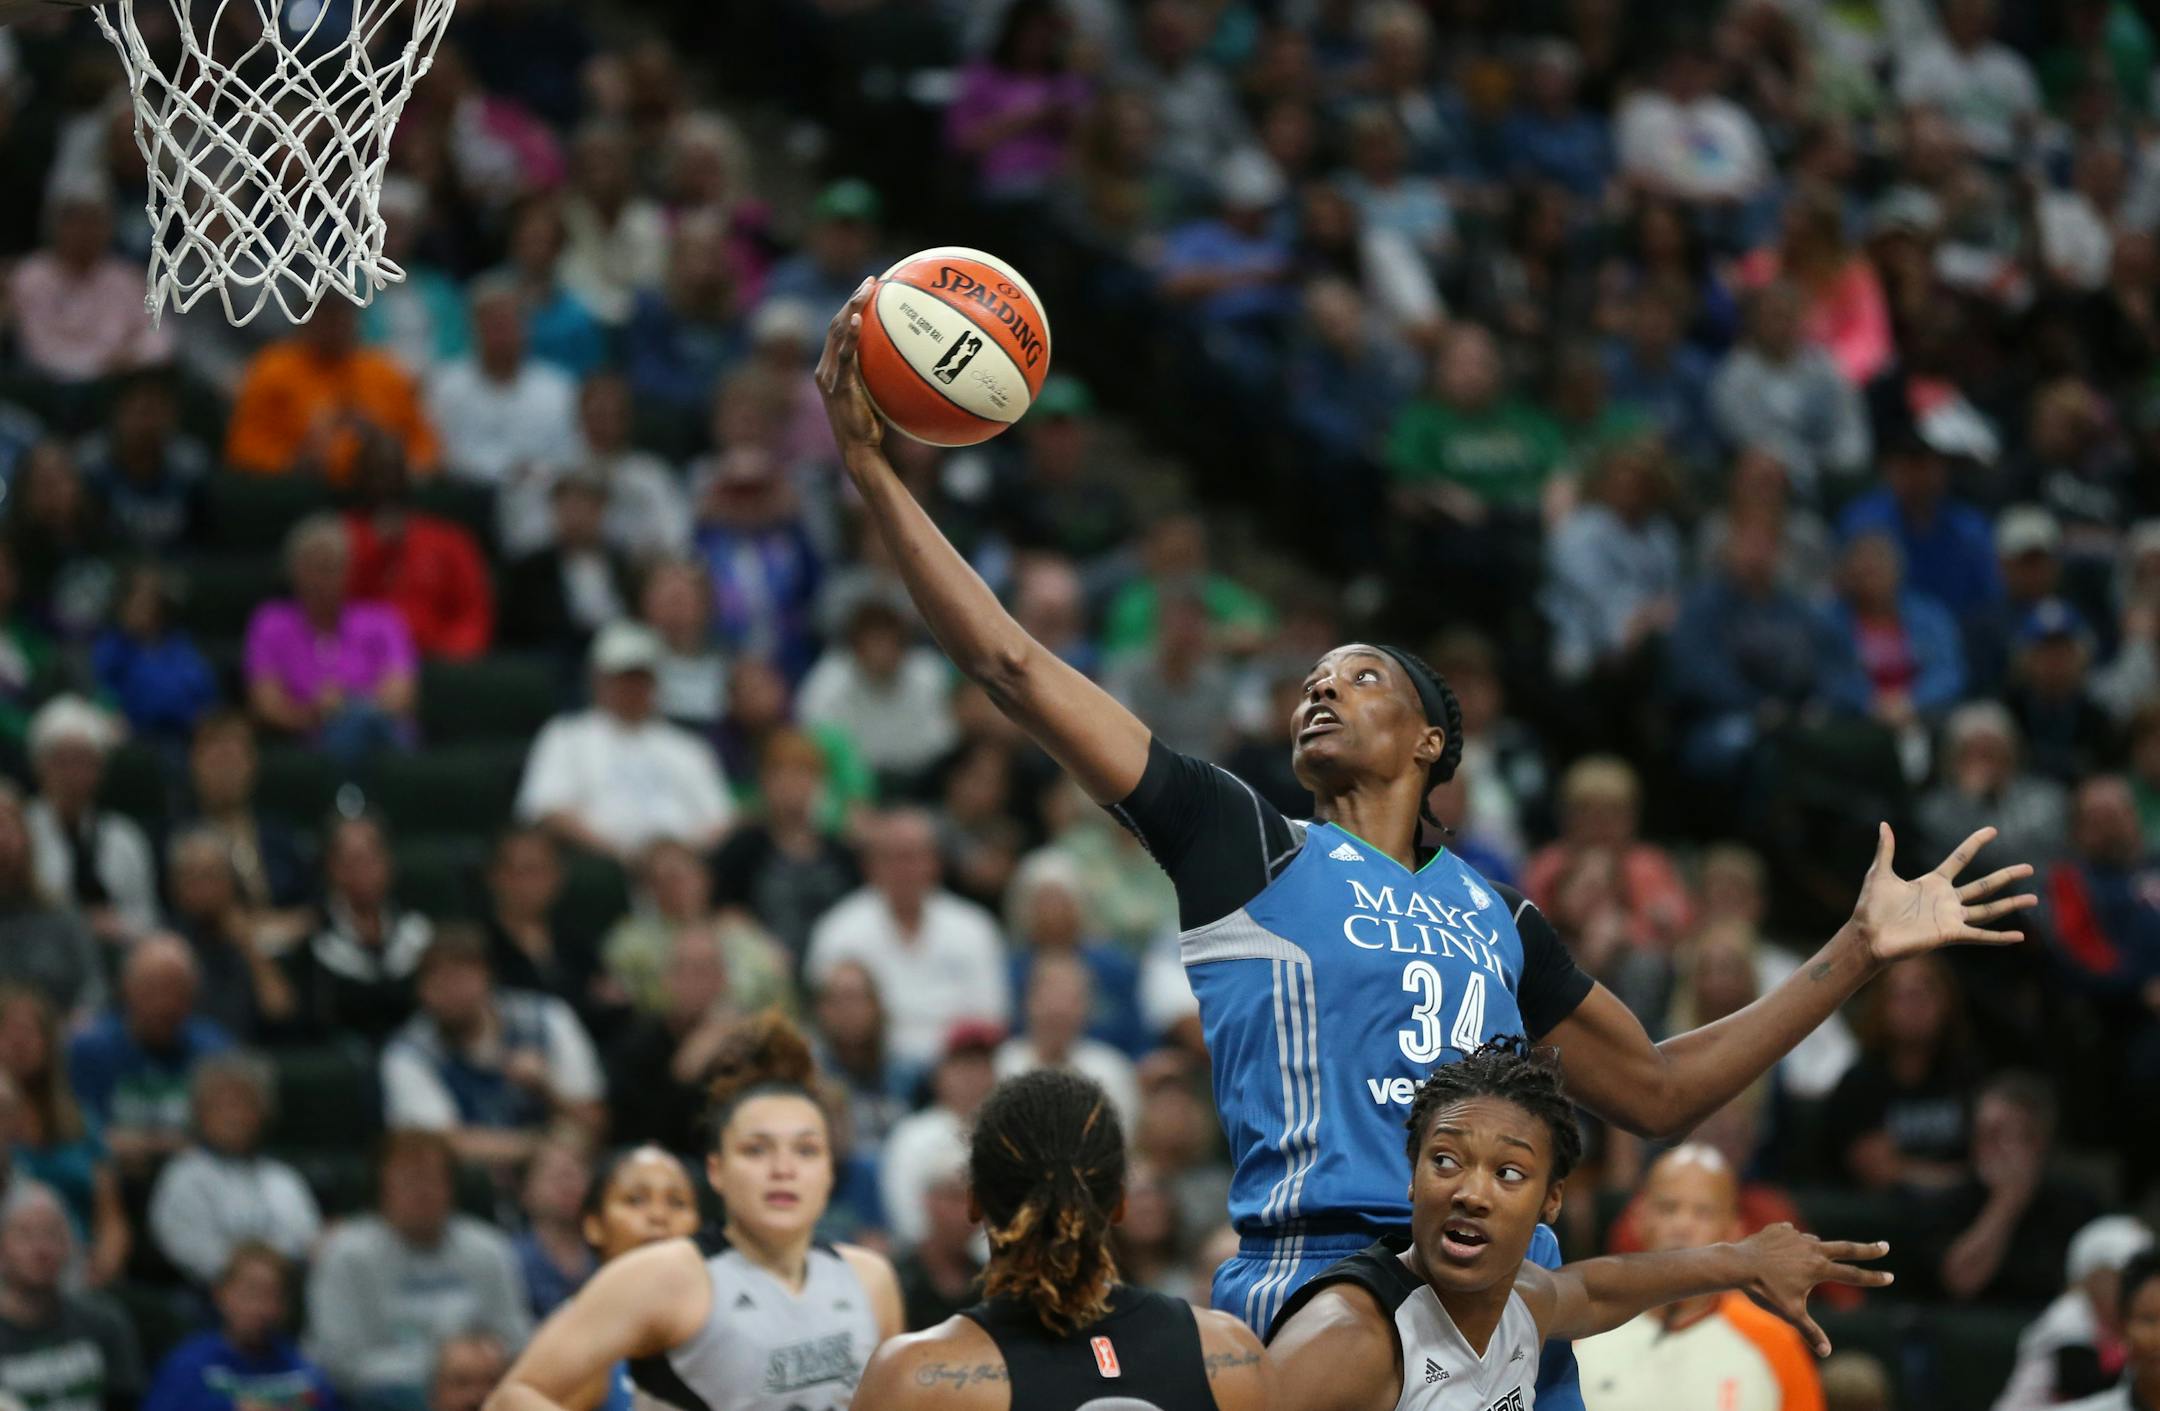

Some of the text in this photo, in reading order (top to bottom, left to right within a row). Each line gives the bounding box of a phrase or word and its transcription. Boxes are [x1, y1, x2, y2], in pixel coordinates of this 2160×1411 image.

[931, 267, 1042, 369] SPALDING
[1328, 852, 1365, 862] adidas
[1399, 960, 1485, 1064] 34
